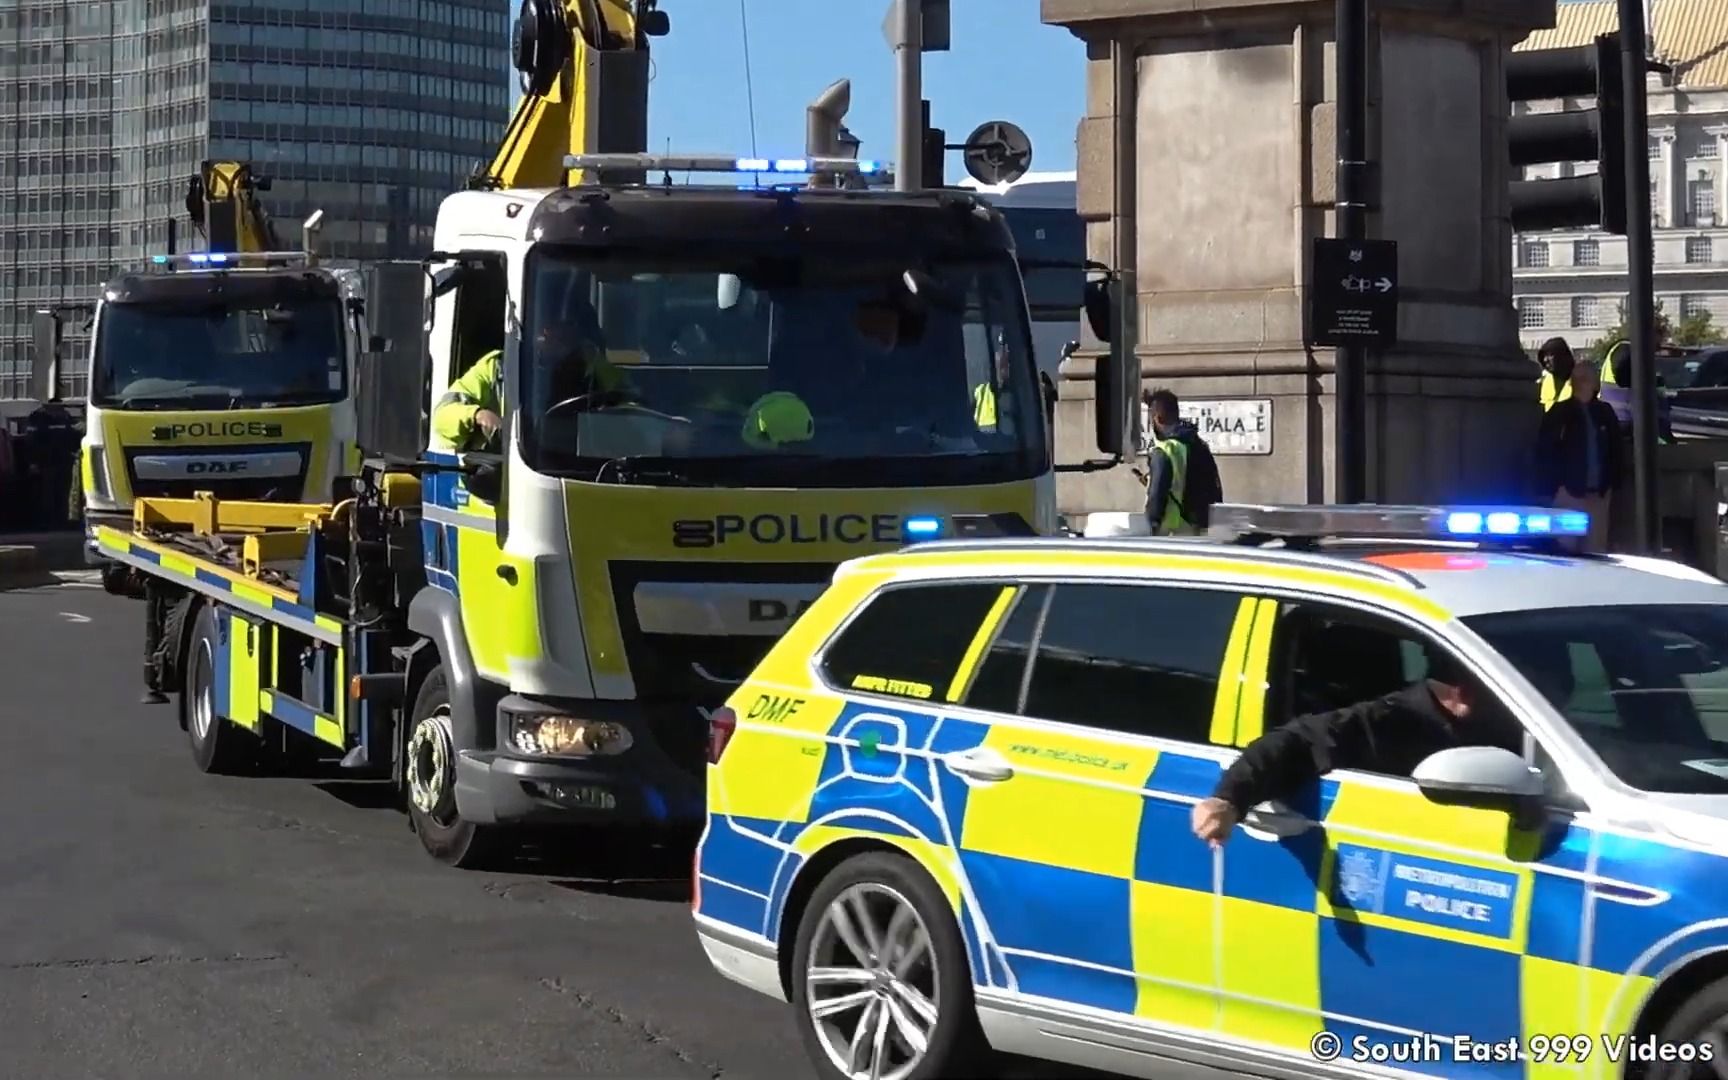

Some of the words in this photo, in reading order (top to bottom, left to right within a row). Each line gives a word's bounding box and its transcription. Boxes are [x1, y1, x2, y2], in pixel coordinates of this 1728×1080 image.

[171, 421, 262, 439] POLICE
[1204, 416, 1266, 433] PALAE
[186, 460, 248, 474] DAF
[716, 514, 900, 544] POLICE
[747, 694, 806, 722] DMF
[1405, 889, 1491, 922] POLICE
